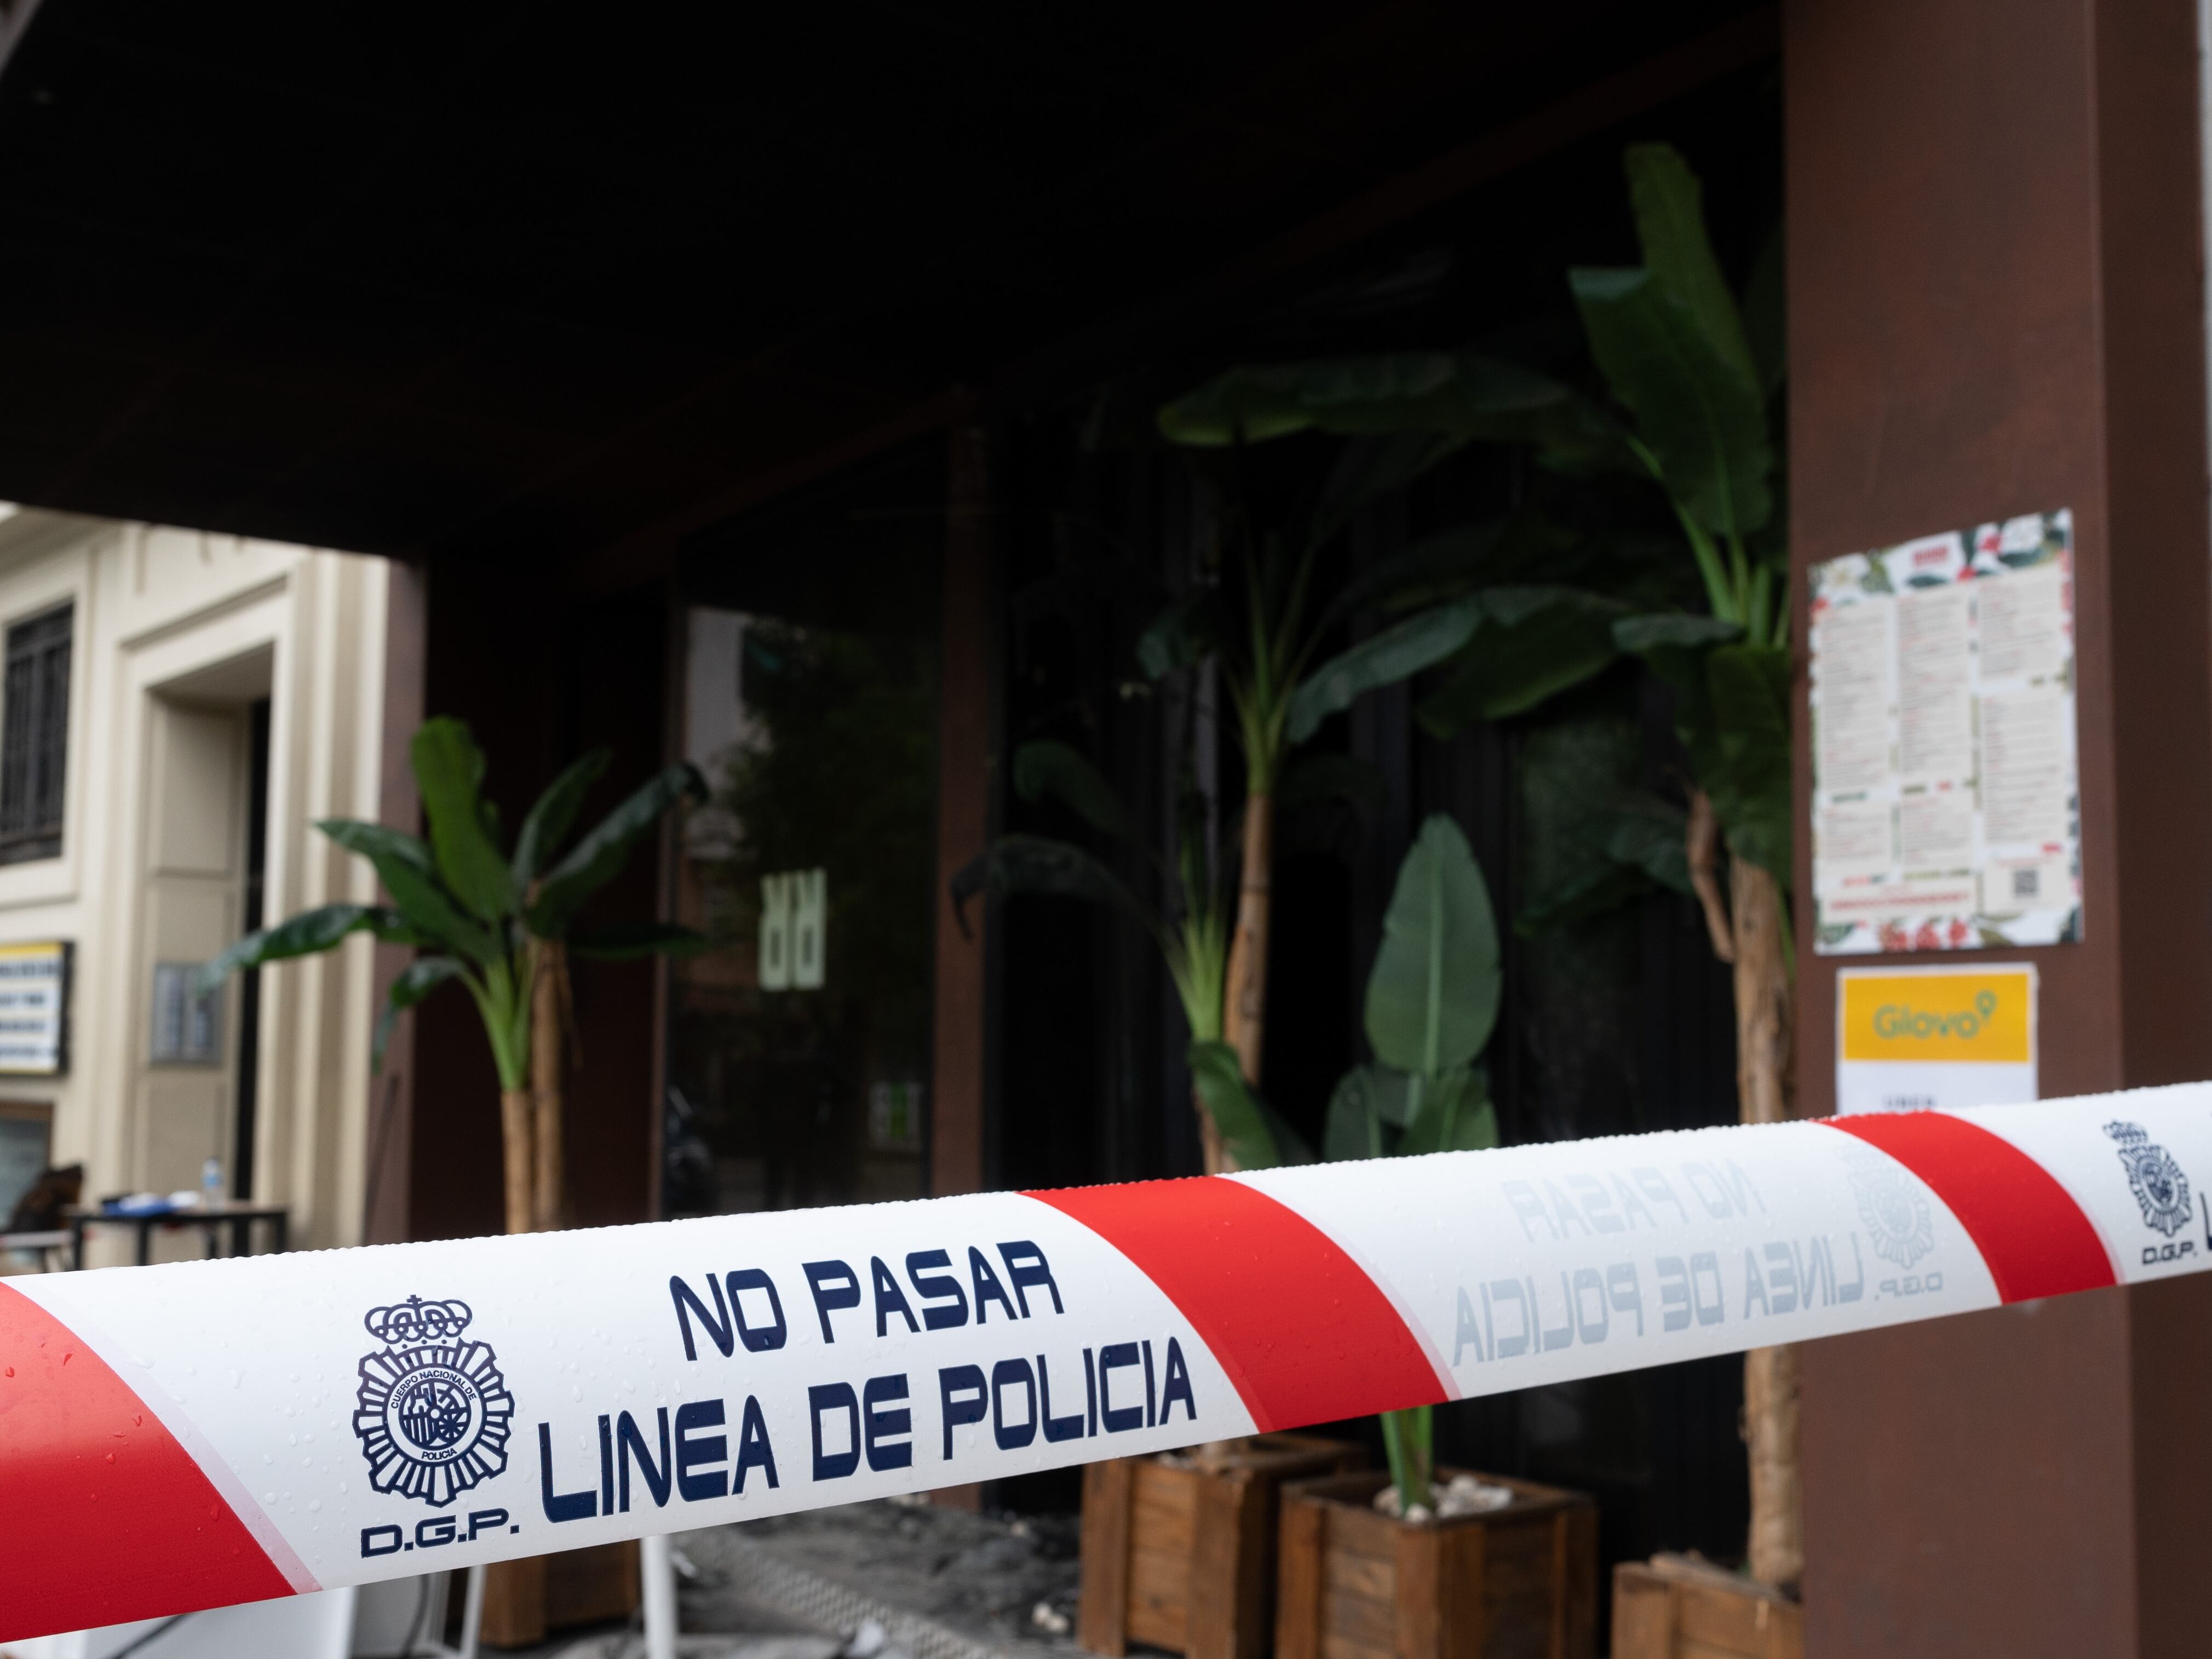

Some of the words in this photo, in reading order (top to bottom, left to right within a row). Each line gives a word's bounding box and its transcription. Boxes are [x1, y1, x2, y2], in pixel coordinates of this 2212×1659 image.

[1873, 1003, 1980, 1038] Glovo
[2142, 1241, 2198, 1266] D.G.P.
[669, 1267, 787, 1361] NO
[801, 1240, 1064, 1344] PASAR
[391, 1375, 418, 1409] CUERPO
[419, 1370, 467, 1389] NACIONAL
[465, 1386, 477, 1400] DE
[538, 1394, 779, 1523] LINEA
[808, 1373, 912, 1481] DE
[938, 1336, 1197, 1460] POLICIA
[421, 1448, 457, 1460] POLICIA
[360, 1508, 520, 1559] D.G.P.
